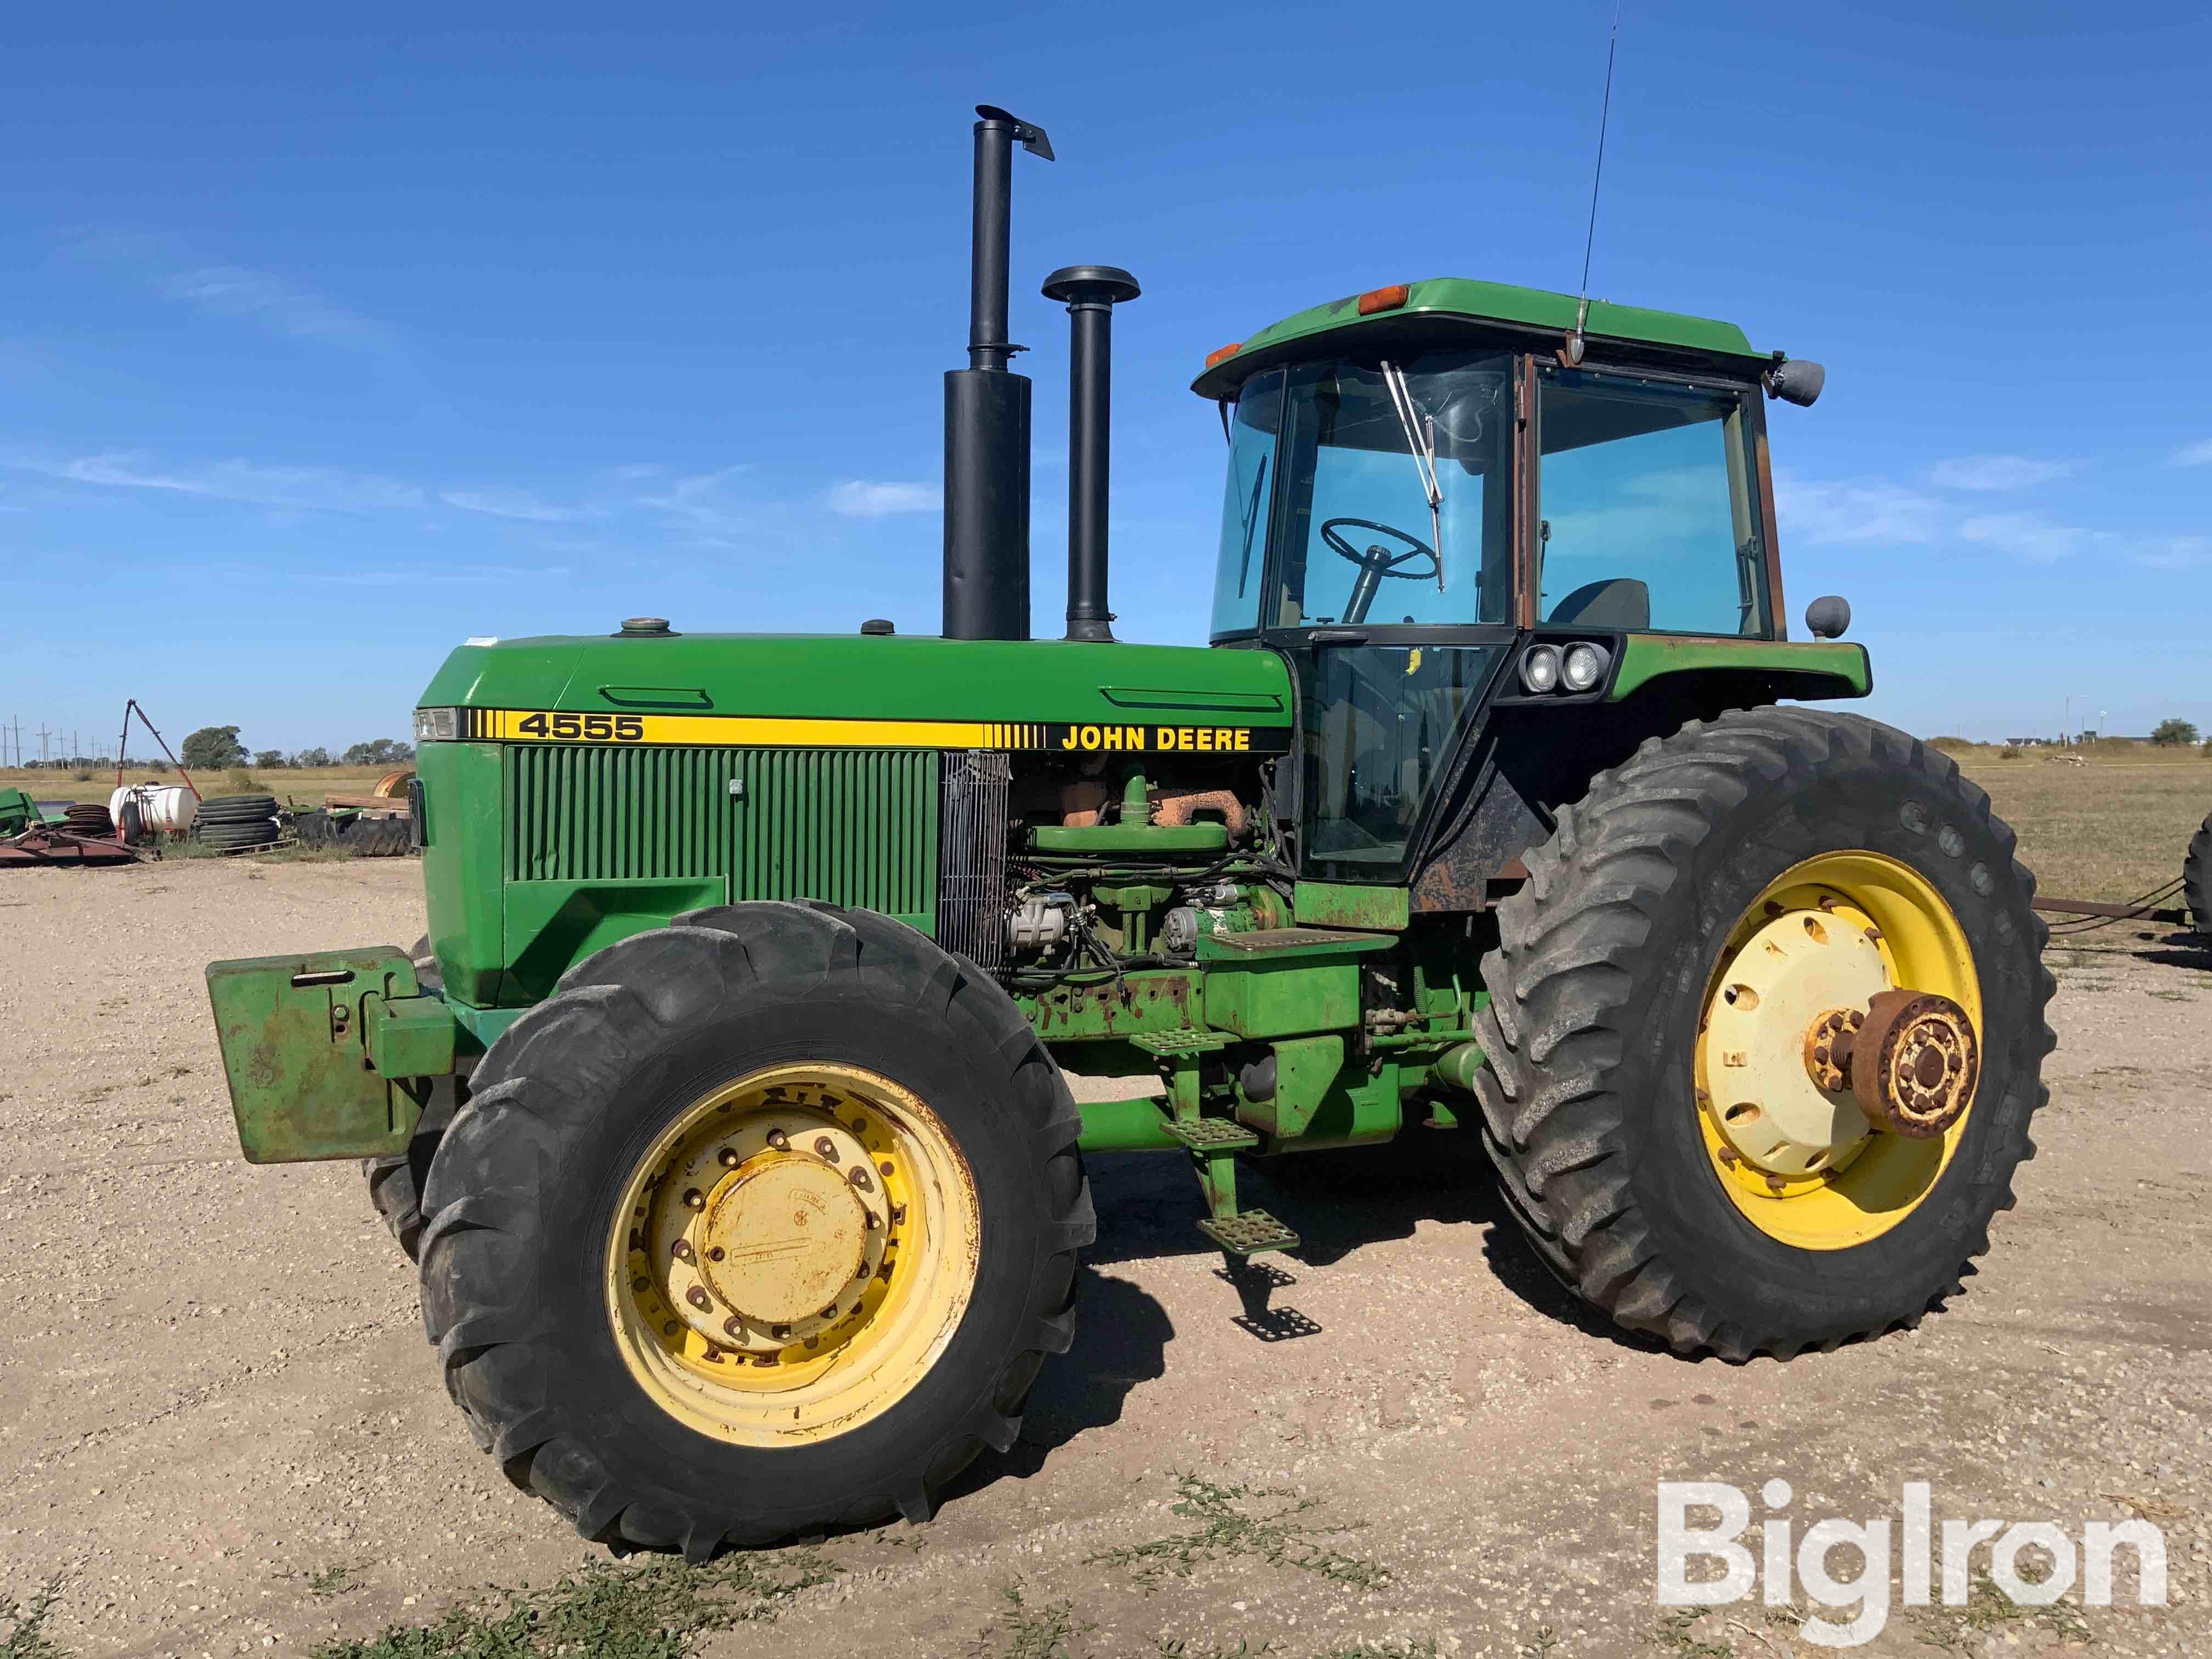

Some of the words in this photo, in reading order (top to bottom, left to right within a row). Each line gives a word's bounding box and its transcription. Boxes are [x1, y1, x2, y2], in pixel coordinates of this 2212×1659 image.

[518, 713, 644, 740] 4555
[1062, 726, 1144, 750] JOHN
[1157, 727, 1250, 751] DEERE
